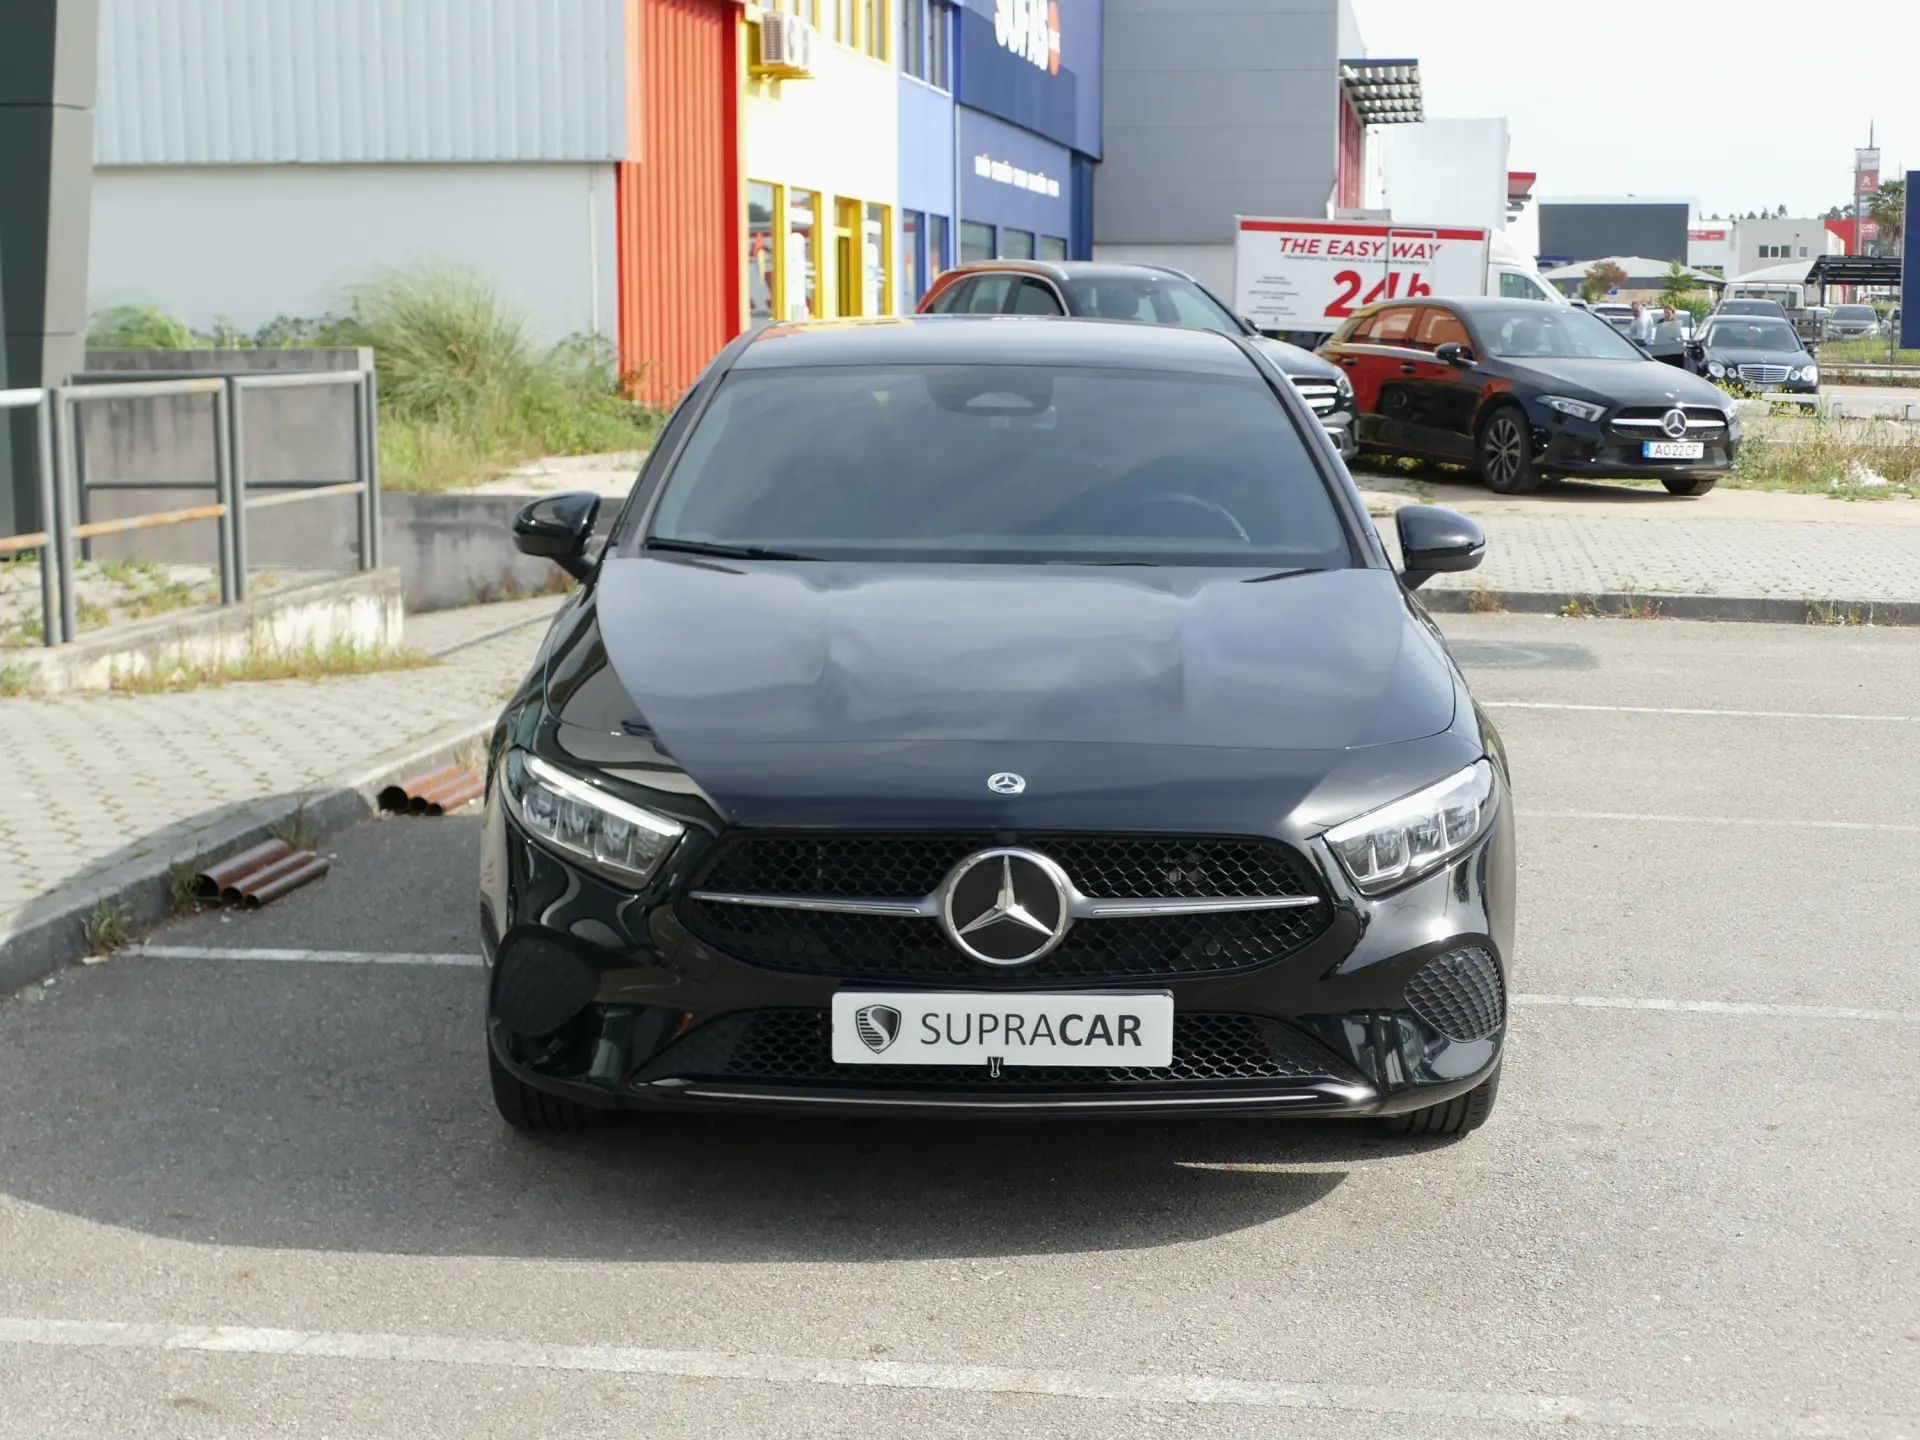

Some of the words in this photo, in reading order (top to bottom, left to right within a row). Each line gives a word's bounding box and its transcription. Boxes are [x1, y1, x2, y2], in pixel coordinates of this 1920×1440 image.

[1280, 238, 1321, 254] THE
[1327, 239, 1384, 257] EASY
[1391, 242, 1442, 259] WAY
[920, 1013, 1143, 1046] SUPRACAR
